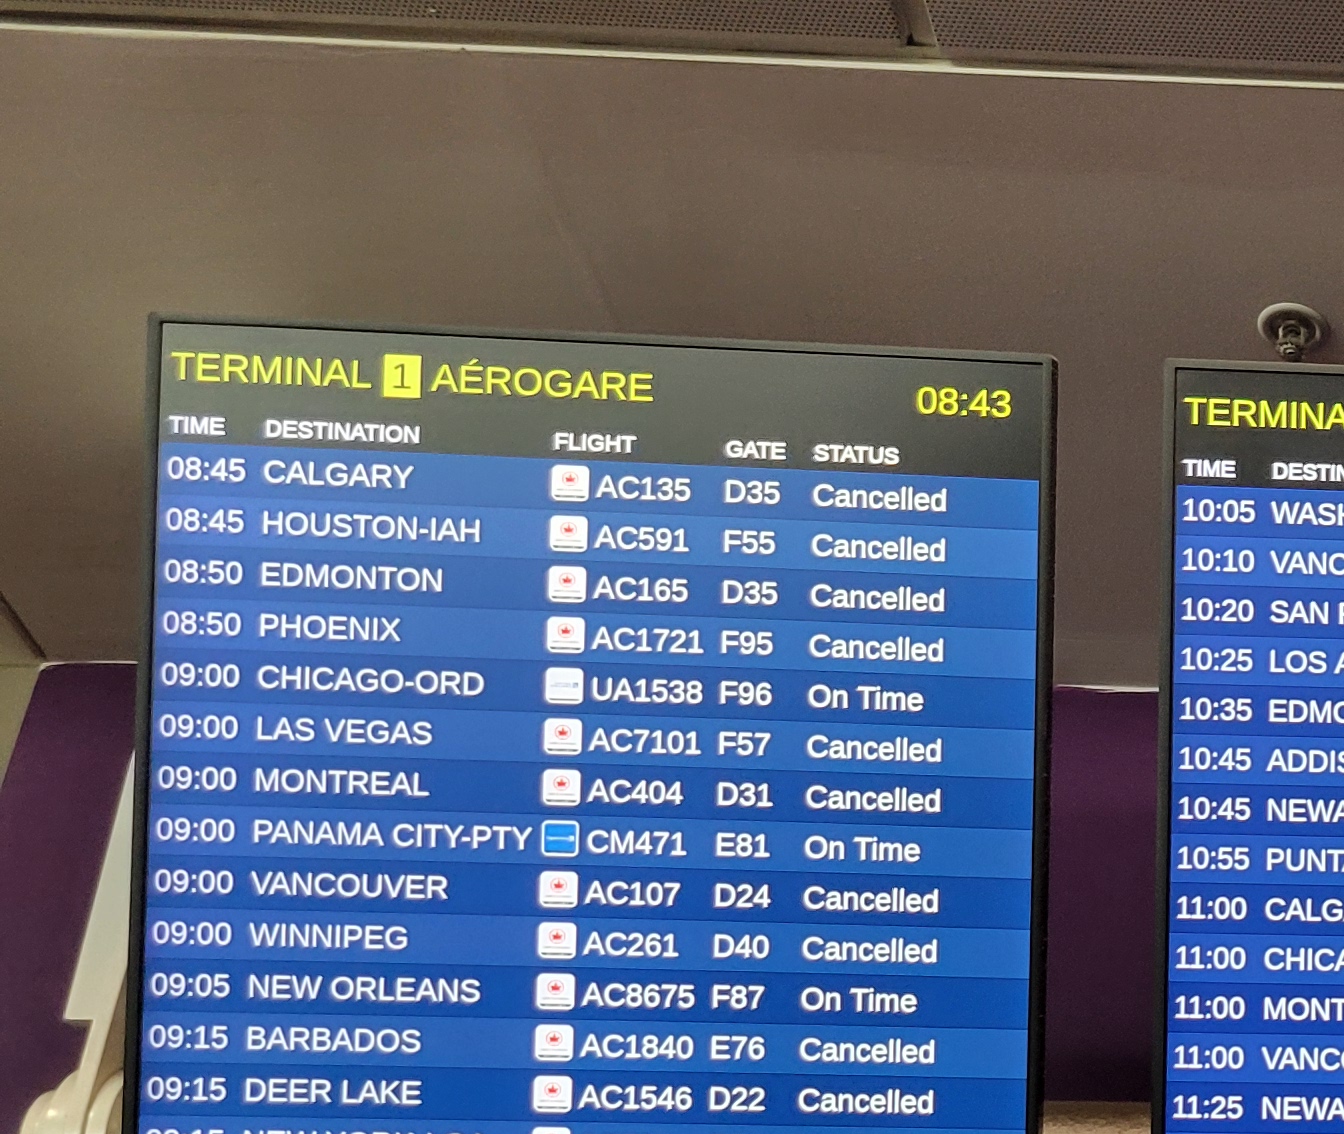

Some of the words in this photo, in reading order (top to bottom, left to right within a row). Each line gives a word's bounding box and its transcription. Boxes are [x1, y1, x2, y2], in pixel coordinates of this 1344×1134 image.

[171, 352, 372, 390] TERMINAL
[431, 359, 655, 402] AÉROGARE
[917, 385, 1013, 420] 08:43
[168, 414, 228, 437] TIME
[263, 418, 422, 445] DESTINATION
[551, 431, 637, 454] FLIGHT
[723, 439, 787, 460] GATE
[811, 443, 900, 465] STATUS
[165, 456, 246, 483] 08:45
[261, 460, 414, 488] CALGARY
[595, 475, 691, 502] AC135
[724, 479, 780, 504] D35
[812, 483, 947, 512] Cancelled
[1181, 459, 1236, 478] TIME
[1182, 548, 1254, 572] 10:10
[159, 714, 238, 739] 09:00
[256, 716, 315, 741] LAS
[324, 718, 432, 745] VEGAS
[588, 728, 701, 755] AC7101
[718, 731, 771, 756] F57
[807, 735, 942, 762] Cancelled
[1179, 747, 1251, 771] 10:45
